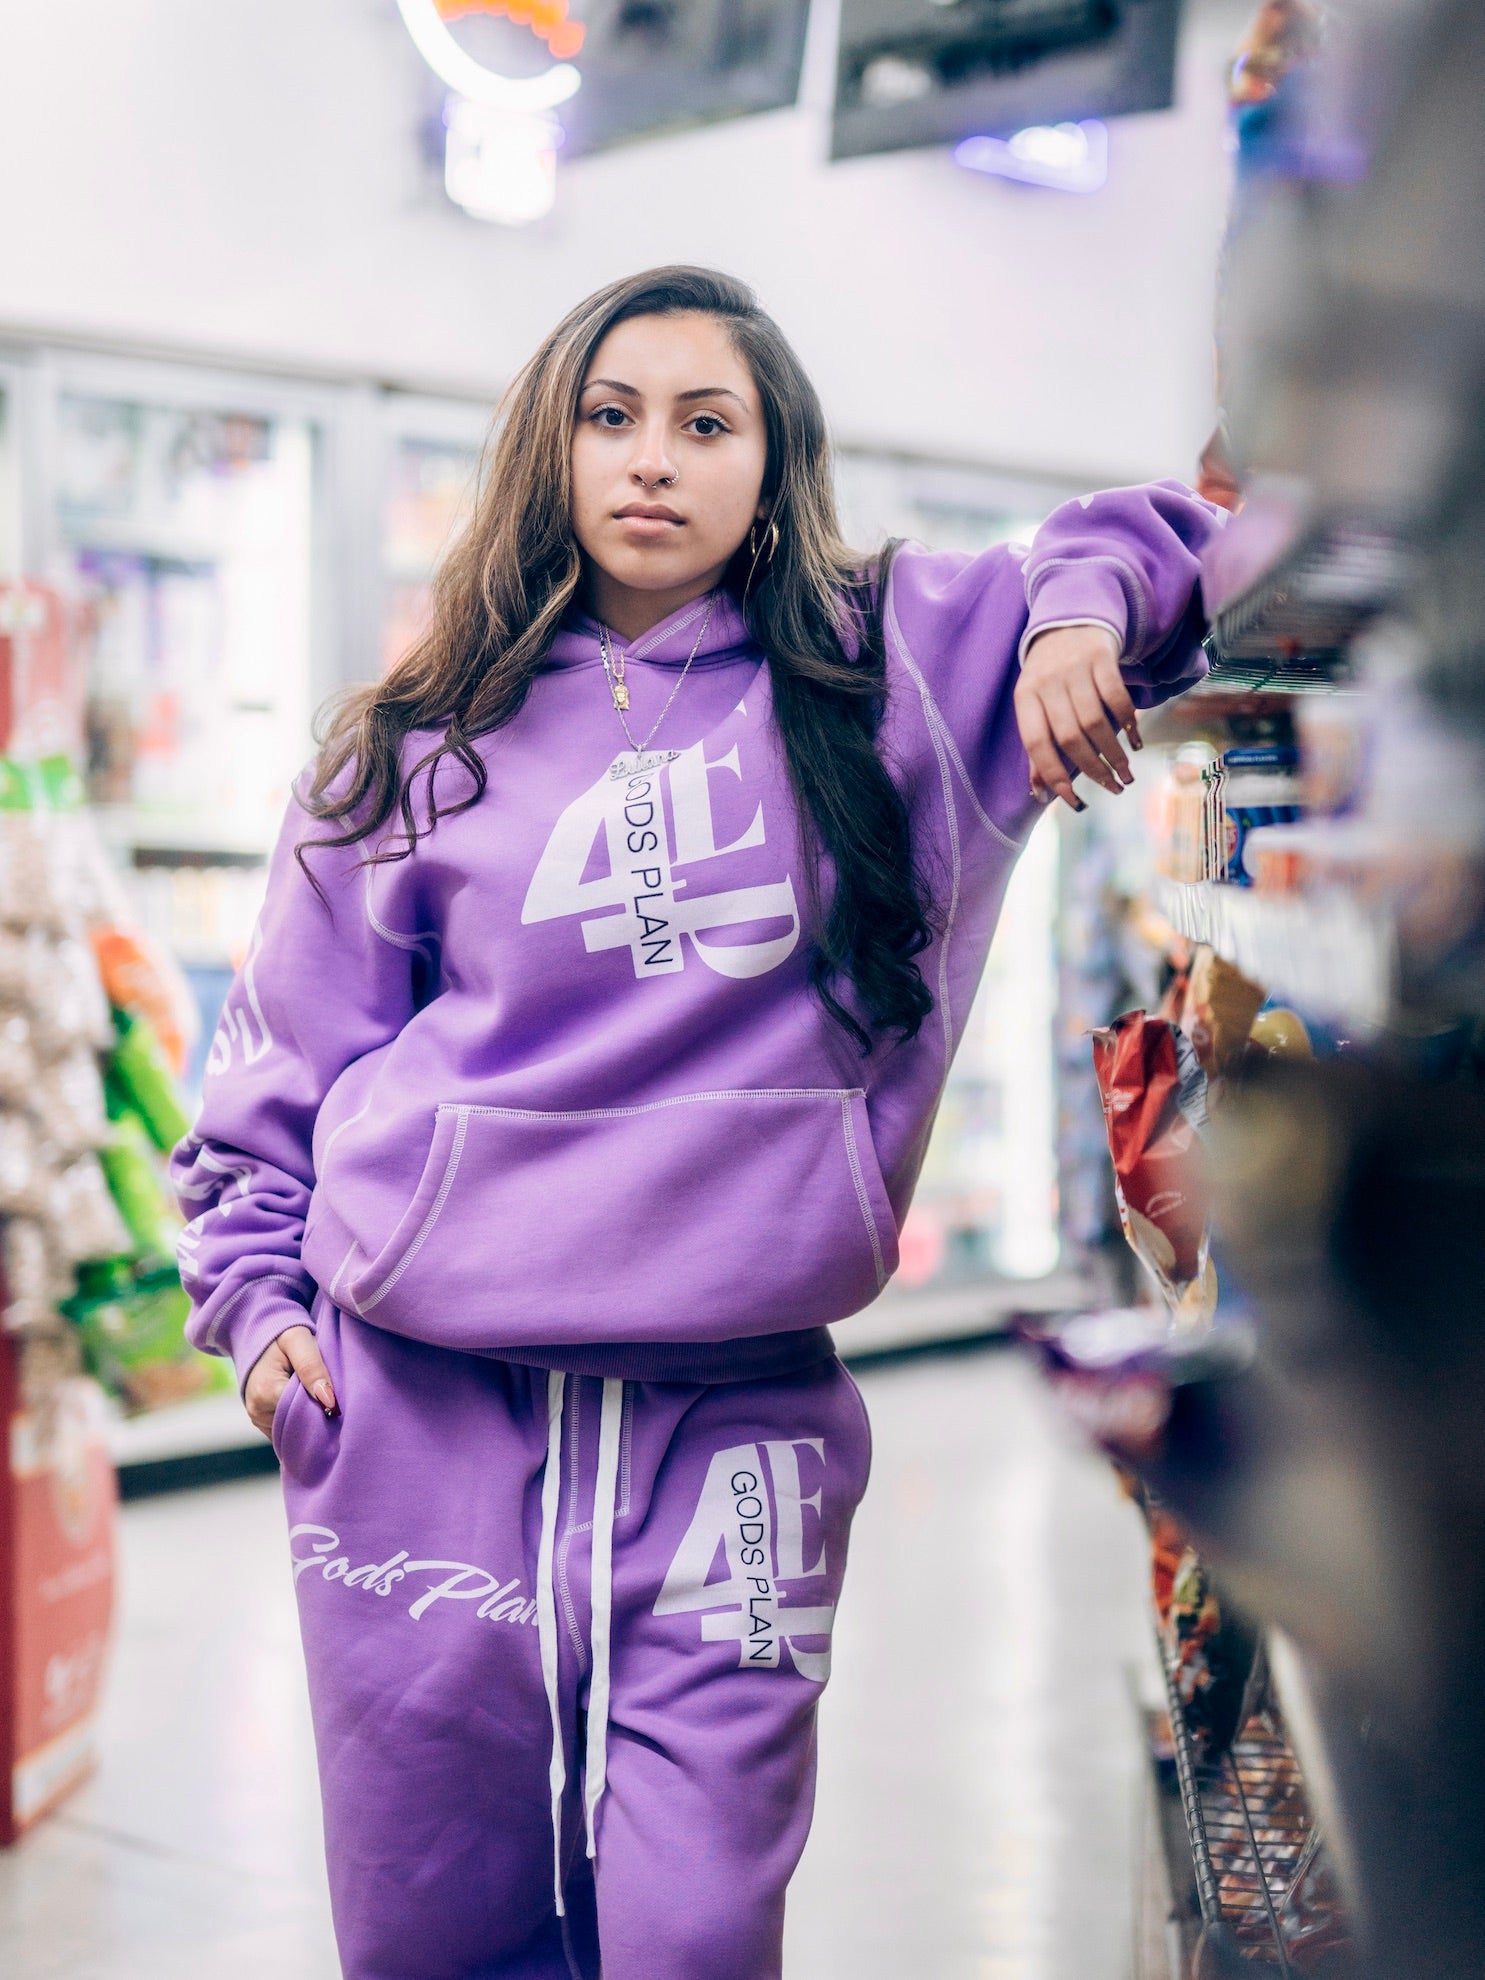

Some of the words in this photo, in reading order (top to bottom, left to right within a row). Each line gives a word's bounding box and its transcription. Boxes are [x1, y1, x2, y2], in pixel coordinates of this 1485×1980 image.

[631, 867, 674, 966] PLAN
[289, 1523, 410, 1597] Gods
[731, 1471, 764, 1566] GODS
[747, 1577, 773, 1661] PLAN
